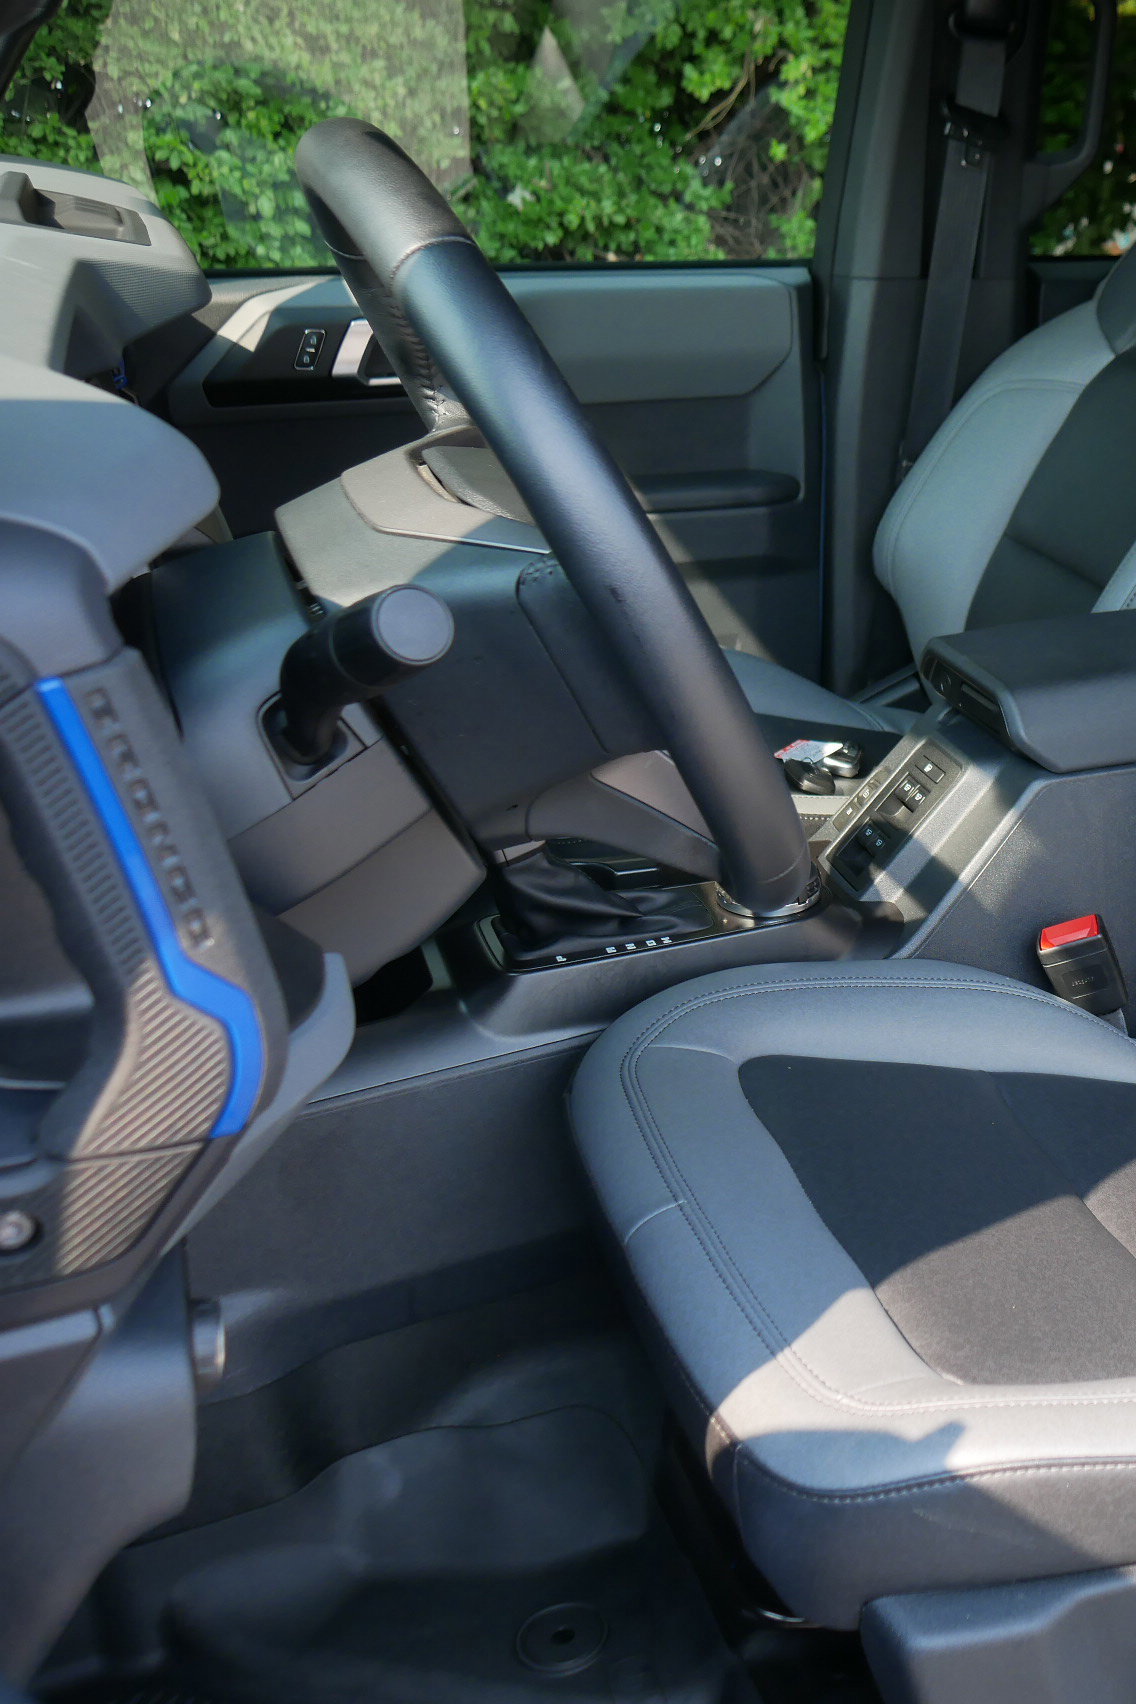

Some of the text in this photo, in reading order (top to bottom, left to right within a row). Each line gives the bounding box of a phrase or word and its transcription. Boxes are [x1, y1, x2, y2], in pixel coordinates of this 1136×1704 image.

[555, 955, 567, 963] P
[625, 942, 637, 950] N
[645, 939, 657, 947] D
